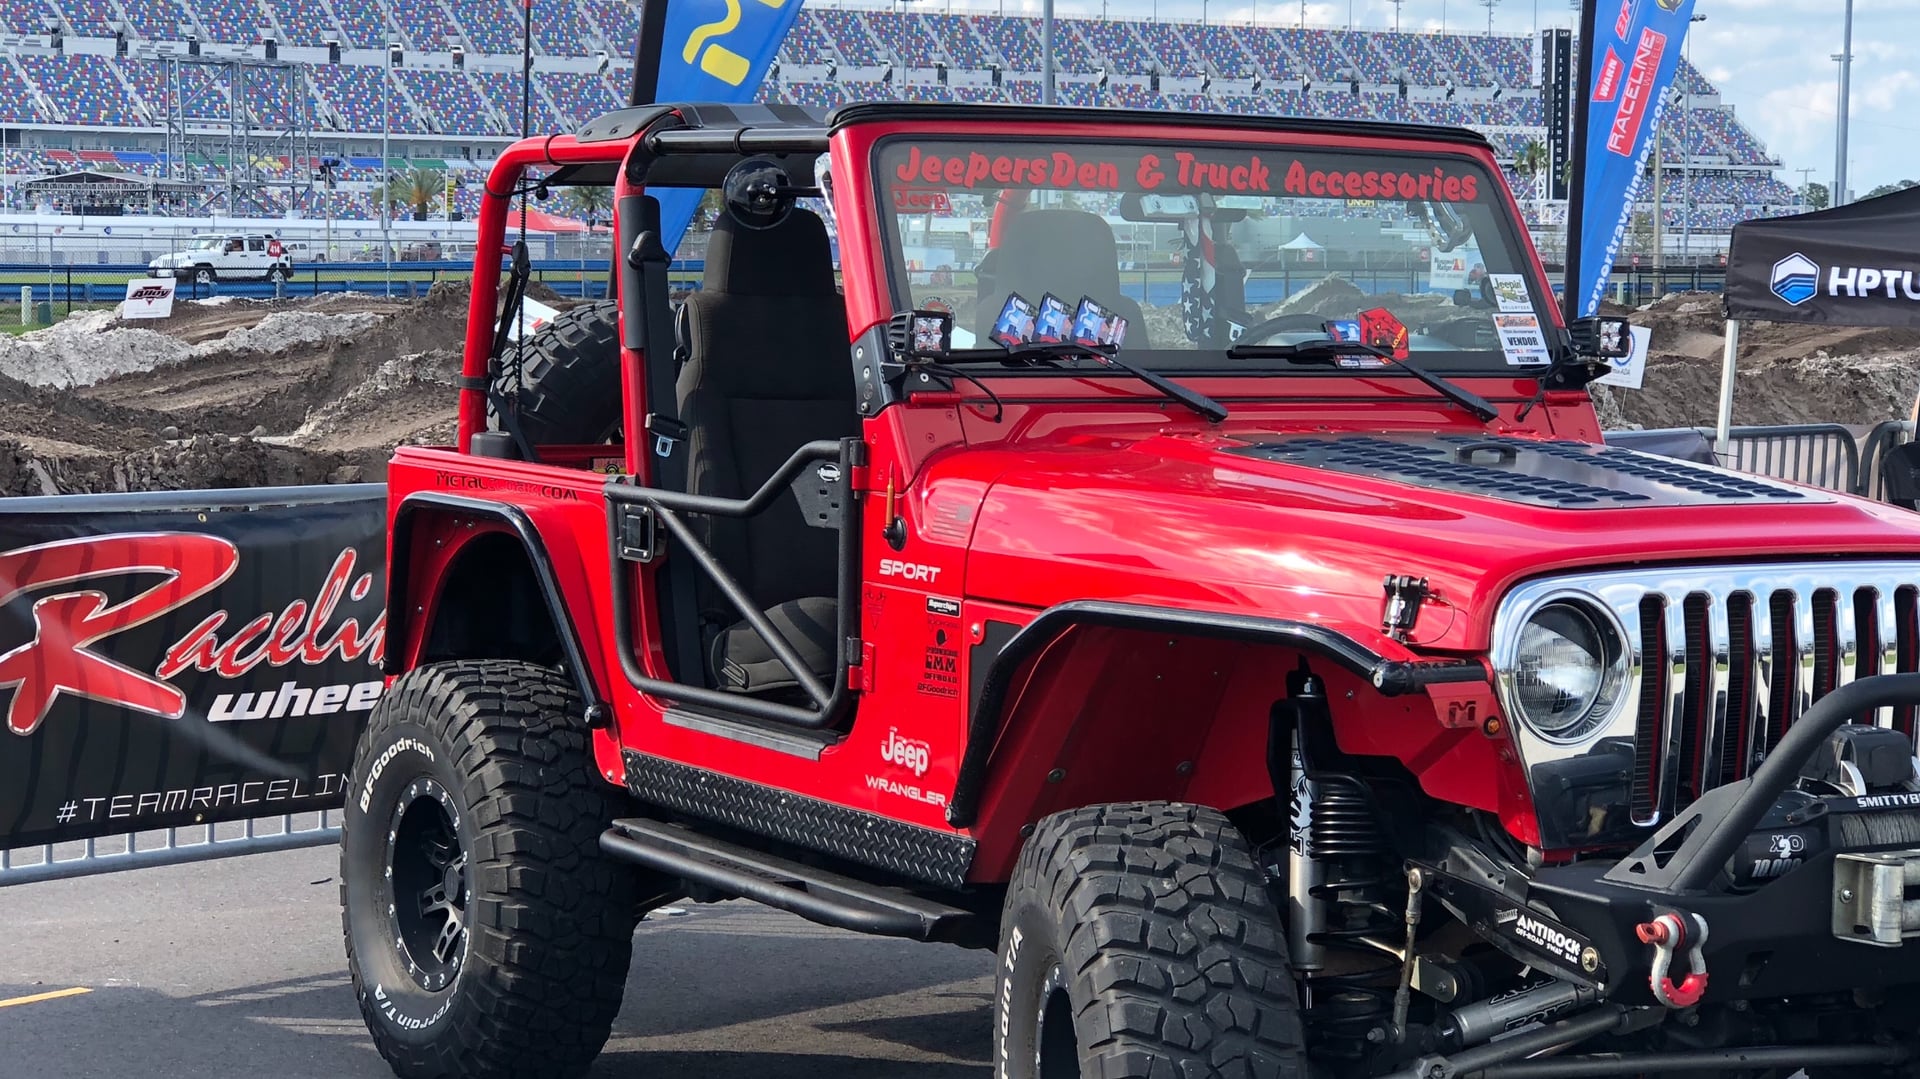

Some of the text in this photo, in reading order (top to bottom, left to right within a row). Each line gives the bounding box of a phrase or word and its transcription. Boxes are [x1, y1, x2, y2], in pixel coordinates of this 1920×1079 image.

[1600, 59, 1617, 97] WARN
[1643, 36, 1664, 87] WHEELS
[1609, 31, 1655, 150] RACELINE
[1136, 155, 1165, 189] &
[1174, 152, 1270, 192] Truck
[1284, 160, 1478, 201] Accessories
[894, 191, 947, 207] Jeep
[269, 244, 280, 254] 414
[131, 289, 168, 298] Alloy
[1829, 266, 1920, 300] HPTU
[1507, 336, 1539, 346] VENDOR
[879, 558, 942, 583] SPORT
[881, 729, 929, 778] Jeep
[359, 738, 435, 815] BFGoodrich
[865, 773, 946, 808] WRANGLER
[1857, 792, 1920, 808] SMITTYB
[1005, 926, 1024, 973] T/A
[1515, 927, 1578, 964] OFF-ROAD SWAY BAR
[1517, 914, 1580, 956] ANTIROCK
